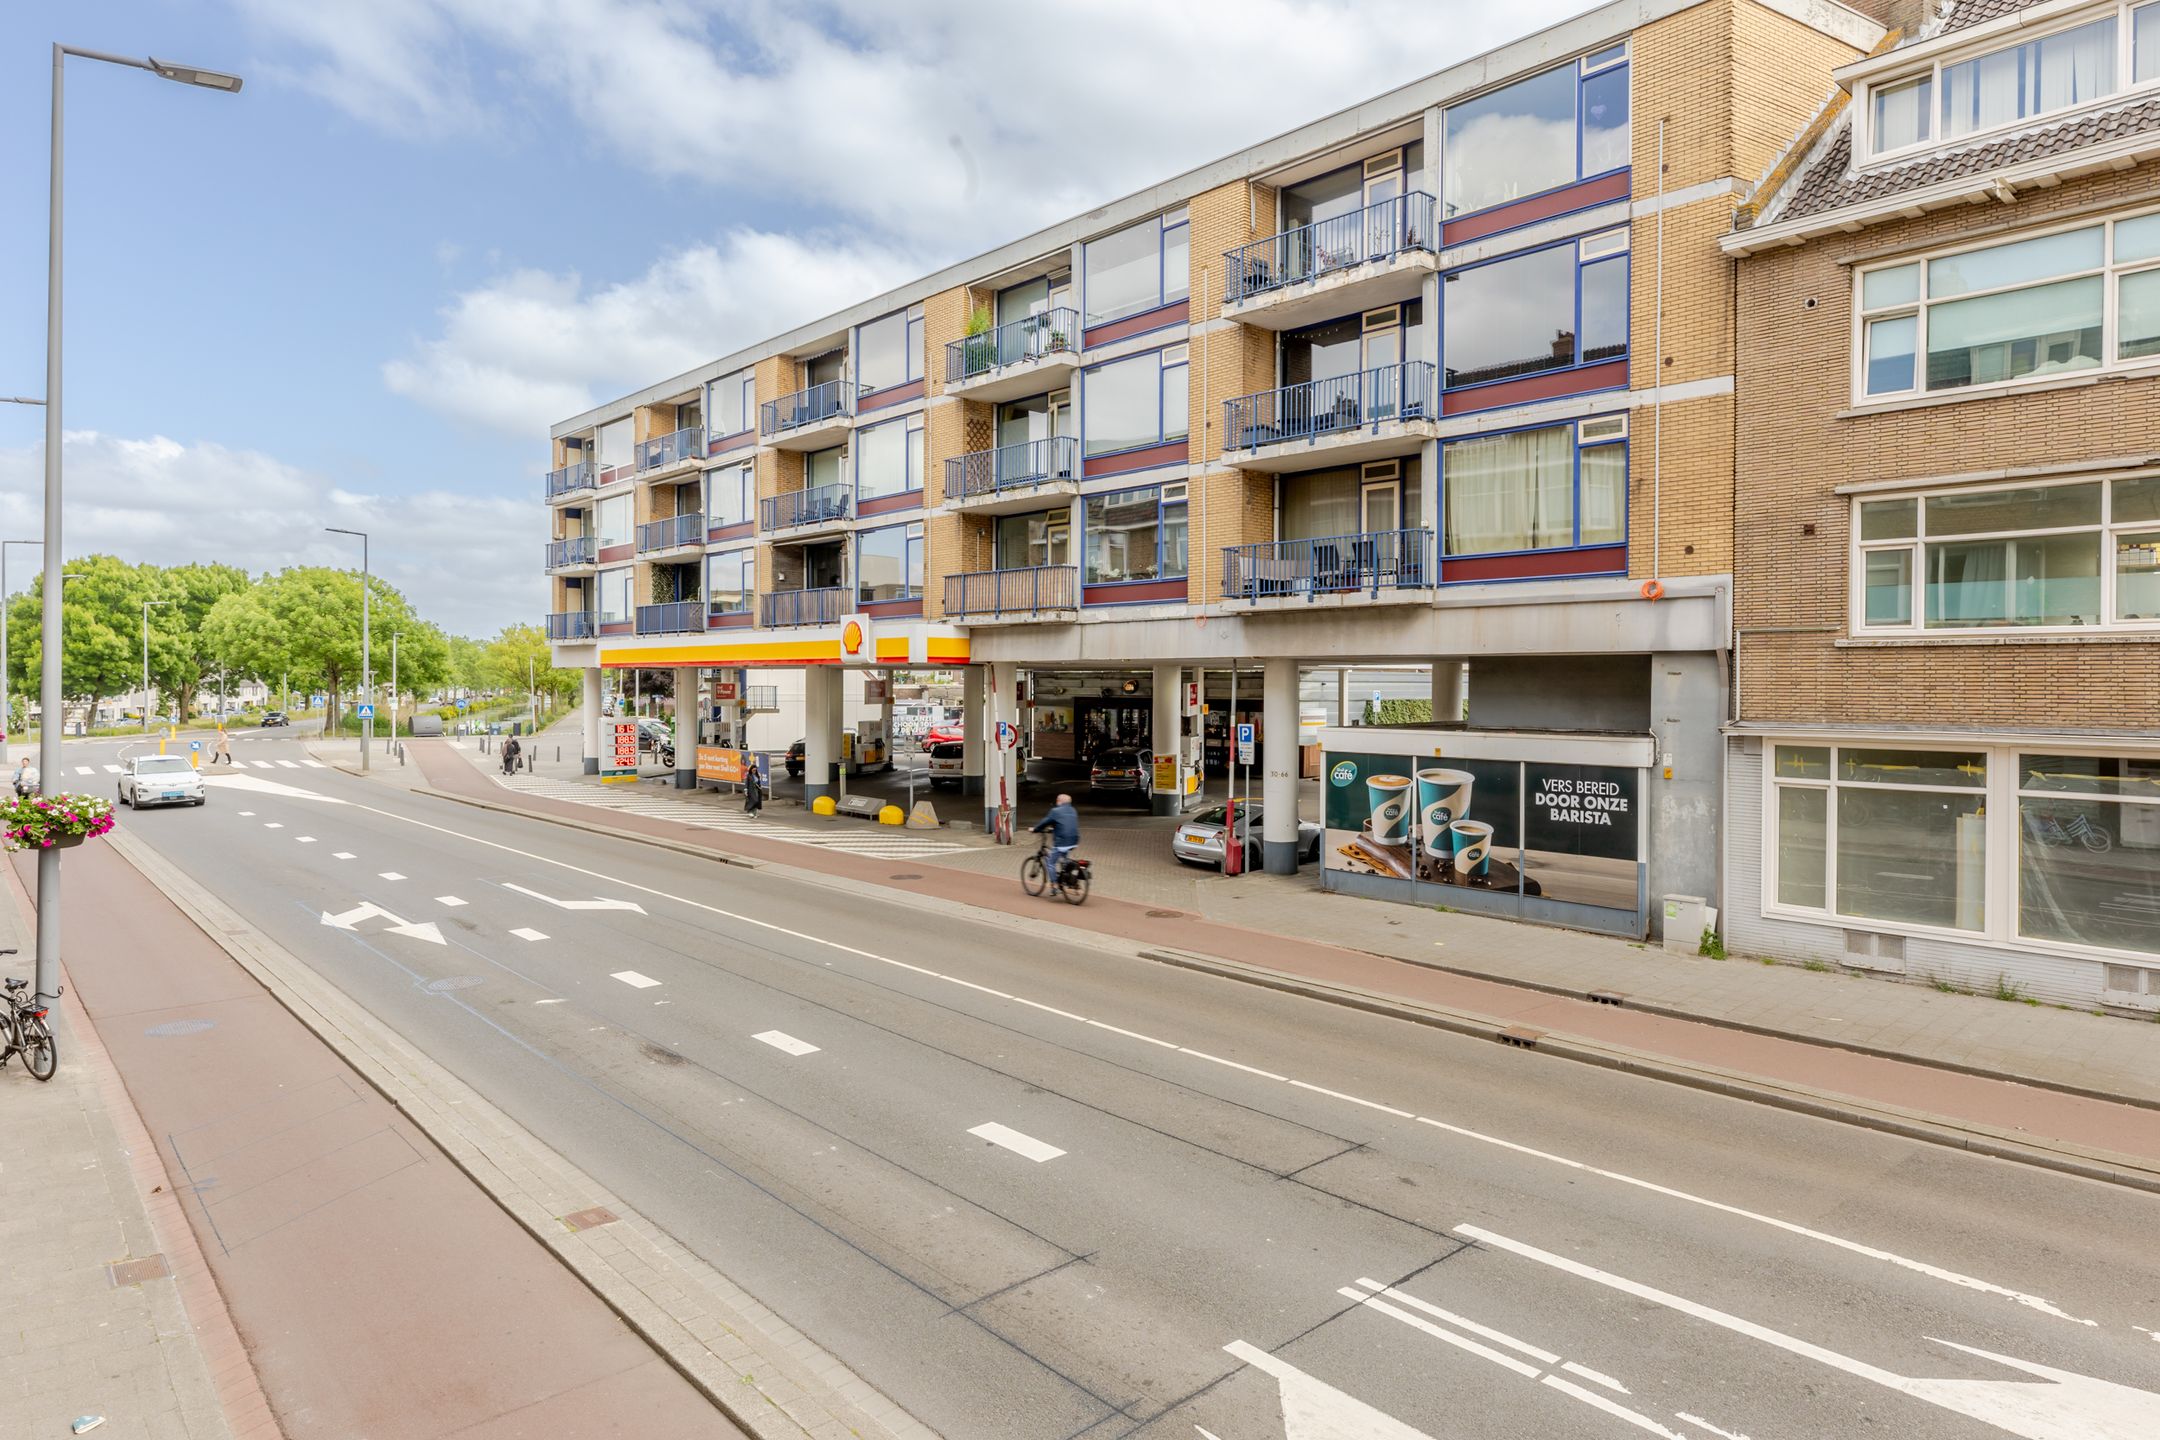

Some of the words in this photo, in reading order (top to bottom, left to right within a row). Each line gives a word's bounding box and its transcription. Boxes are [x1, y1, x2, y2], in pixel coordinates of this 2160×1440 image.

[1242, 728, 1249, 740] P
[1334, 769, 1353, 781] café
[1542, 778, 1572, 792] VERS
[1576, 781, 1619, 795] BEREID
[1535, 792, 1580, 808] DOOR
[1583, 795, 1628, 812] ONZE
[1432, 812, 1448, 821] café
[1550, 808, 1611, 825] BARISTA
